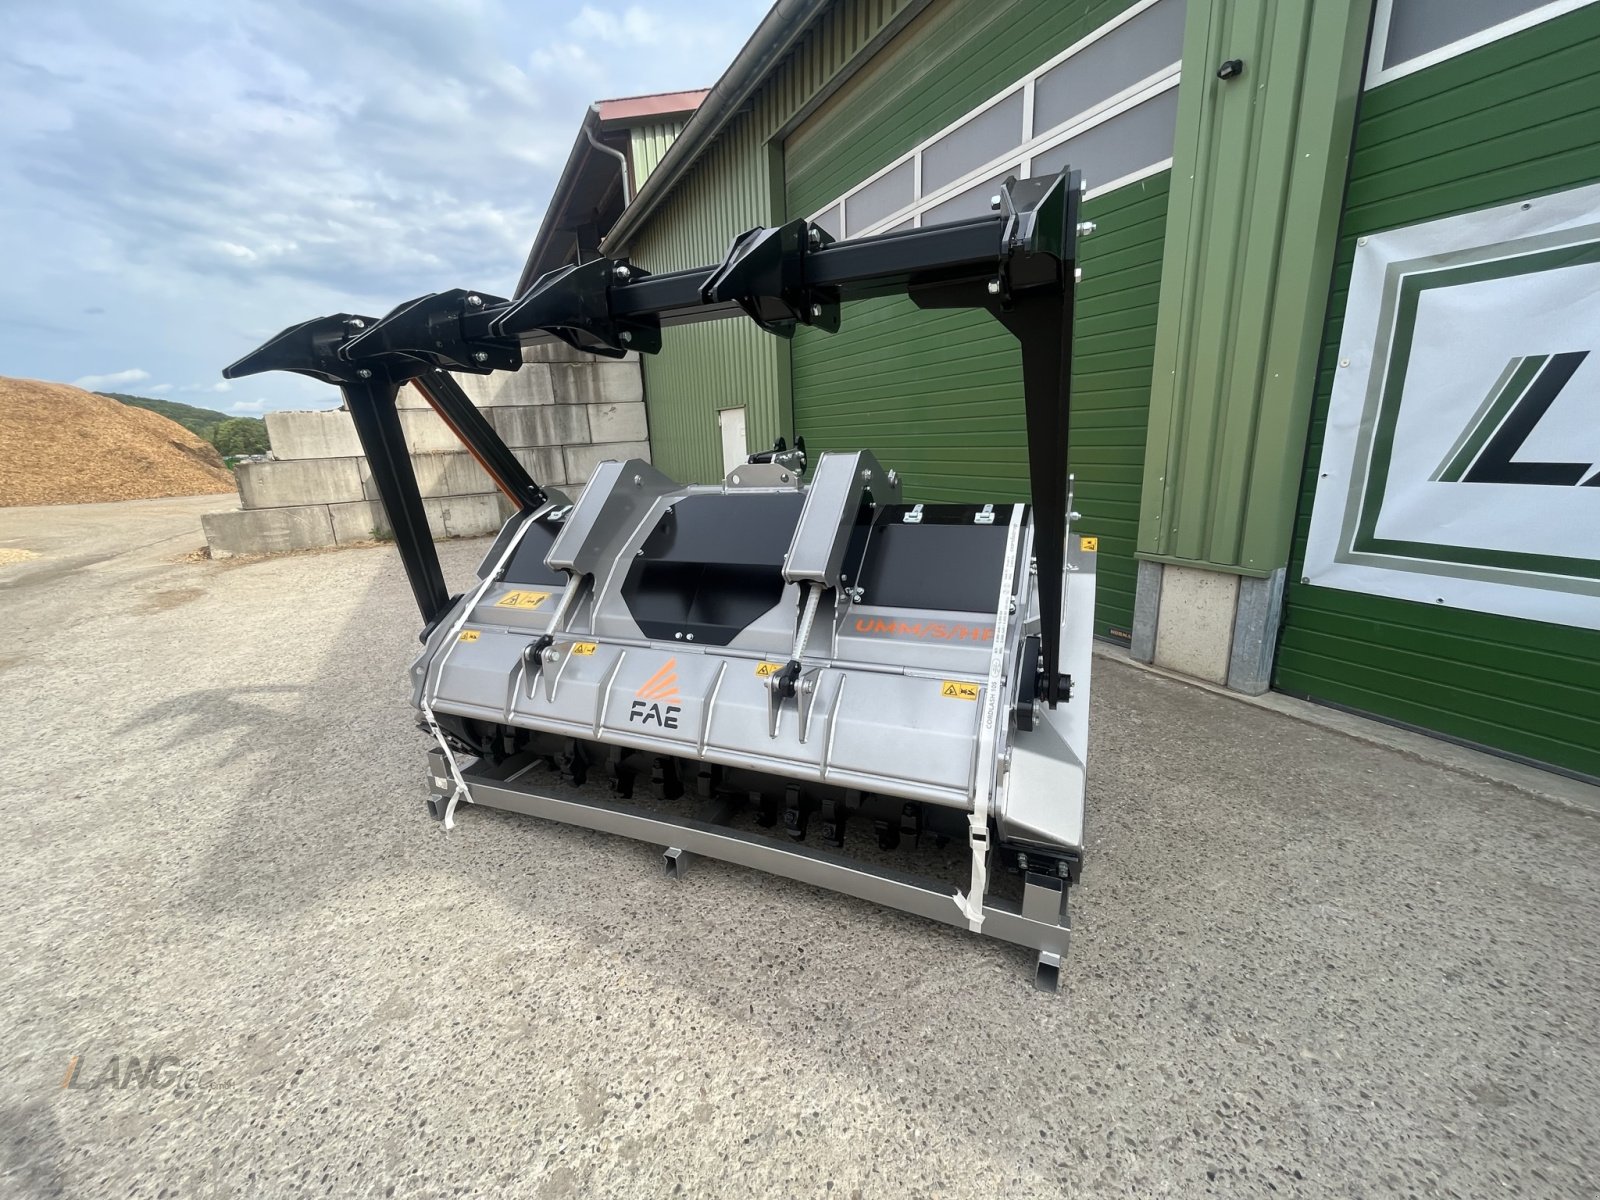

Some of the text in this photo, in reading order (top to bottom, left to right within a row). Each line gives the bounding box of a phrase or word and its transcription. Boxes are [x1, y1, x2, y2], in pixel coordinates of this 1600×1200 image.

[1461, 350, 1600, 487] L
[629, 700, 682, 730] FAE
[985, 693, 997, 730] CORDLASH
